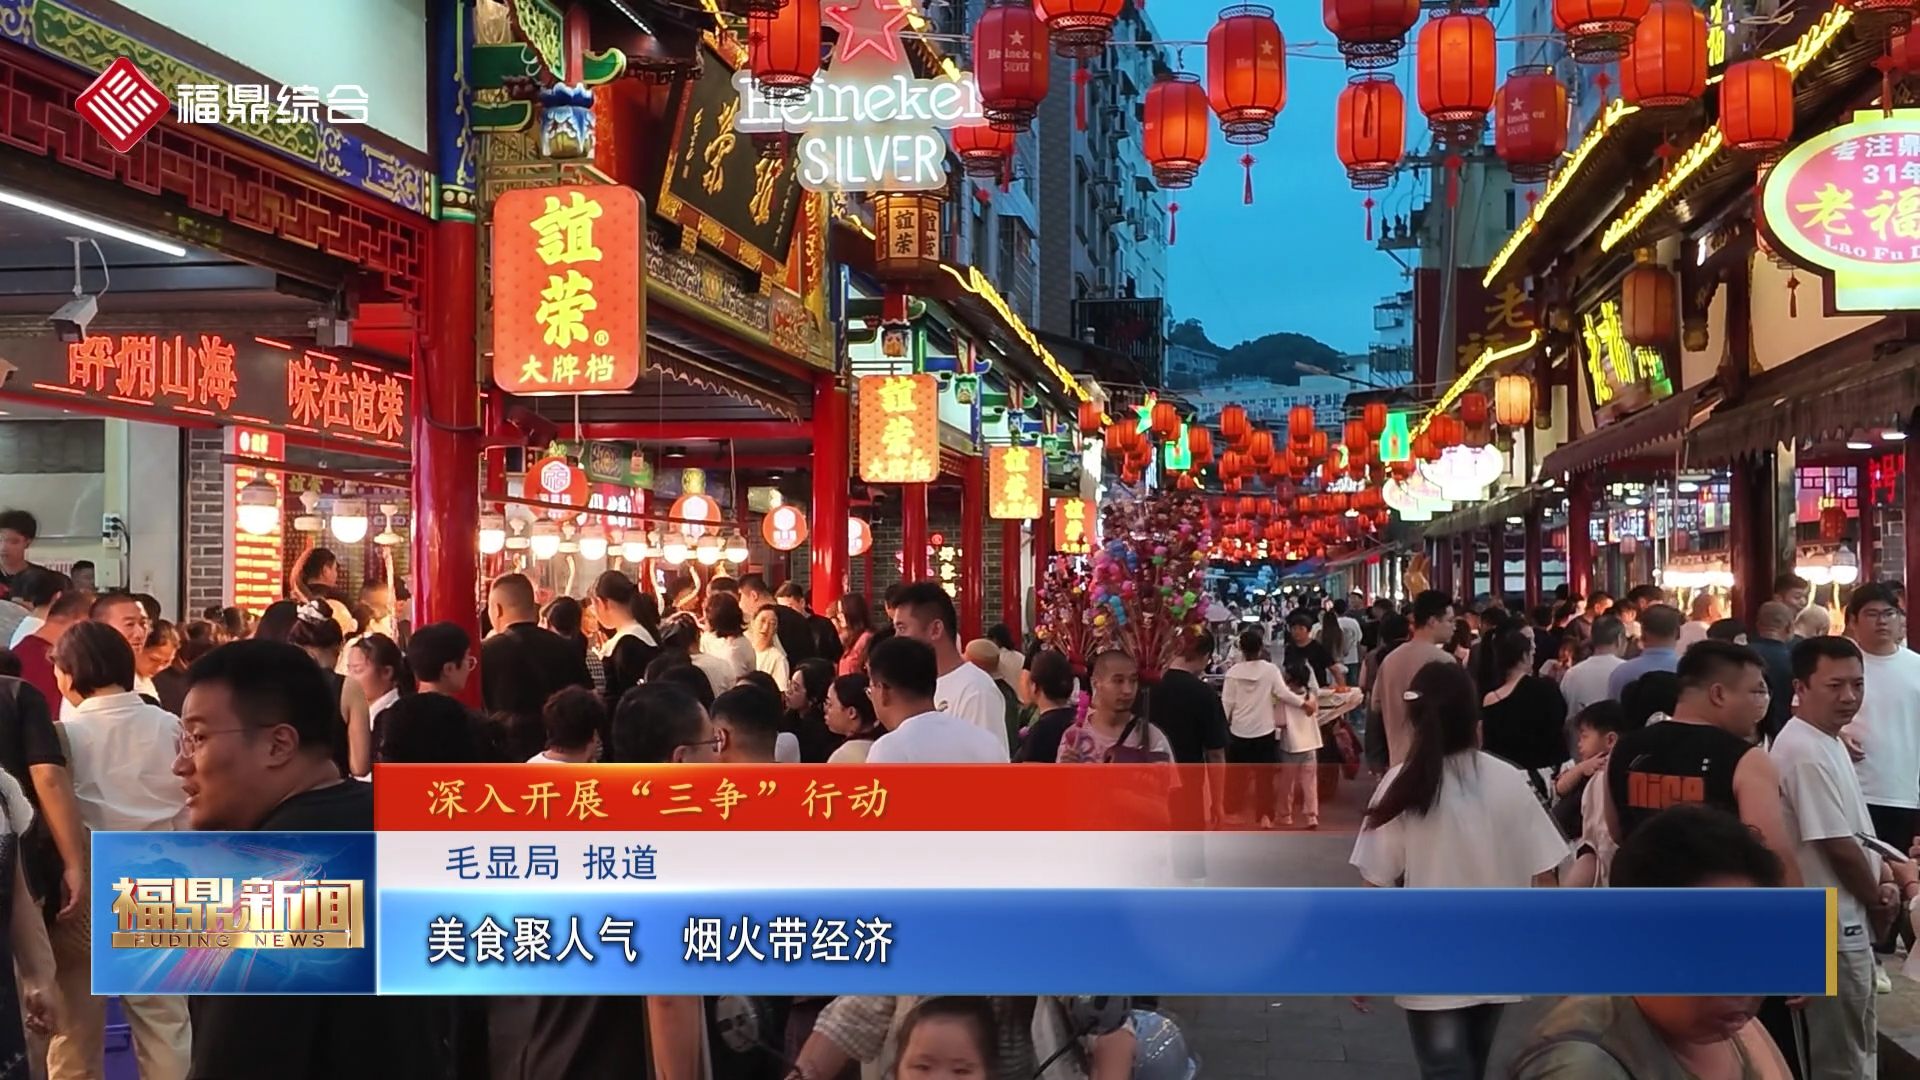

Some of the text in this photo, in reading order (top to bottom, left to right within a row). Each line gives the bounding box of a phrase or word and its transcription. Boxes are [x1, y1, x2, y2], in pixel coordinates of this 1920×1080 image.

[804, 135, 938, 185] SILVER
[1863, 161, 1920, 184] 31年
[1795, 183, 1920, 241] 老福
[1824, 233, 1867, 258] Lao
[1873, 247, 1903, 260] Fu
[518, 353, 615, 385] 大牌档
